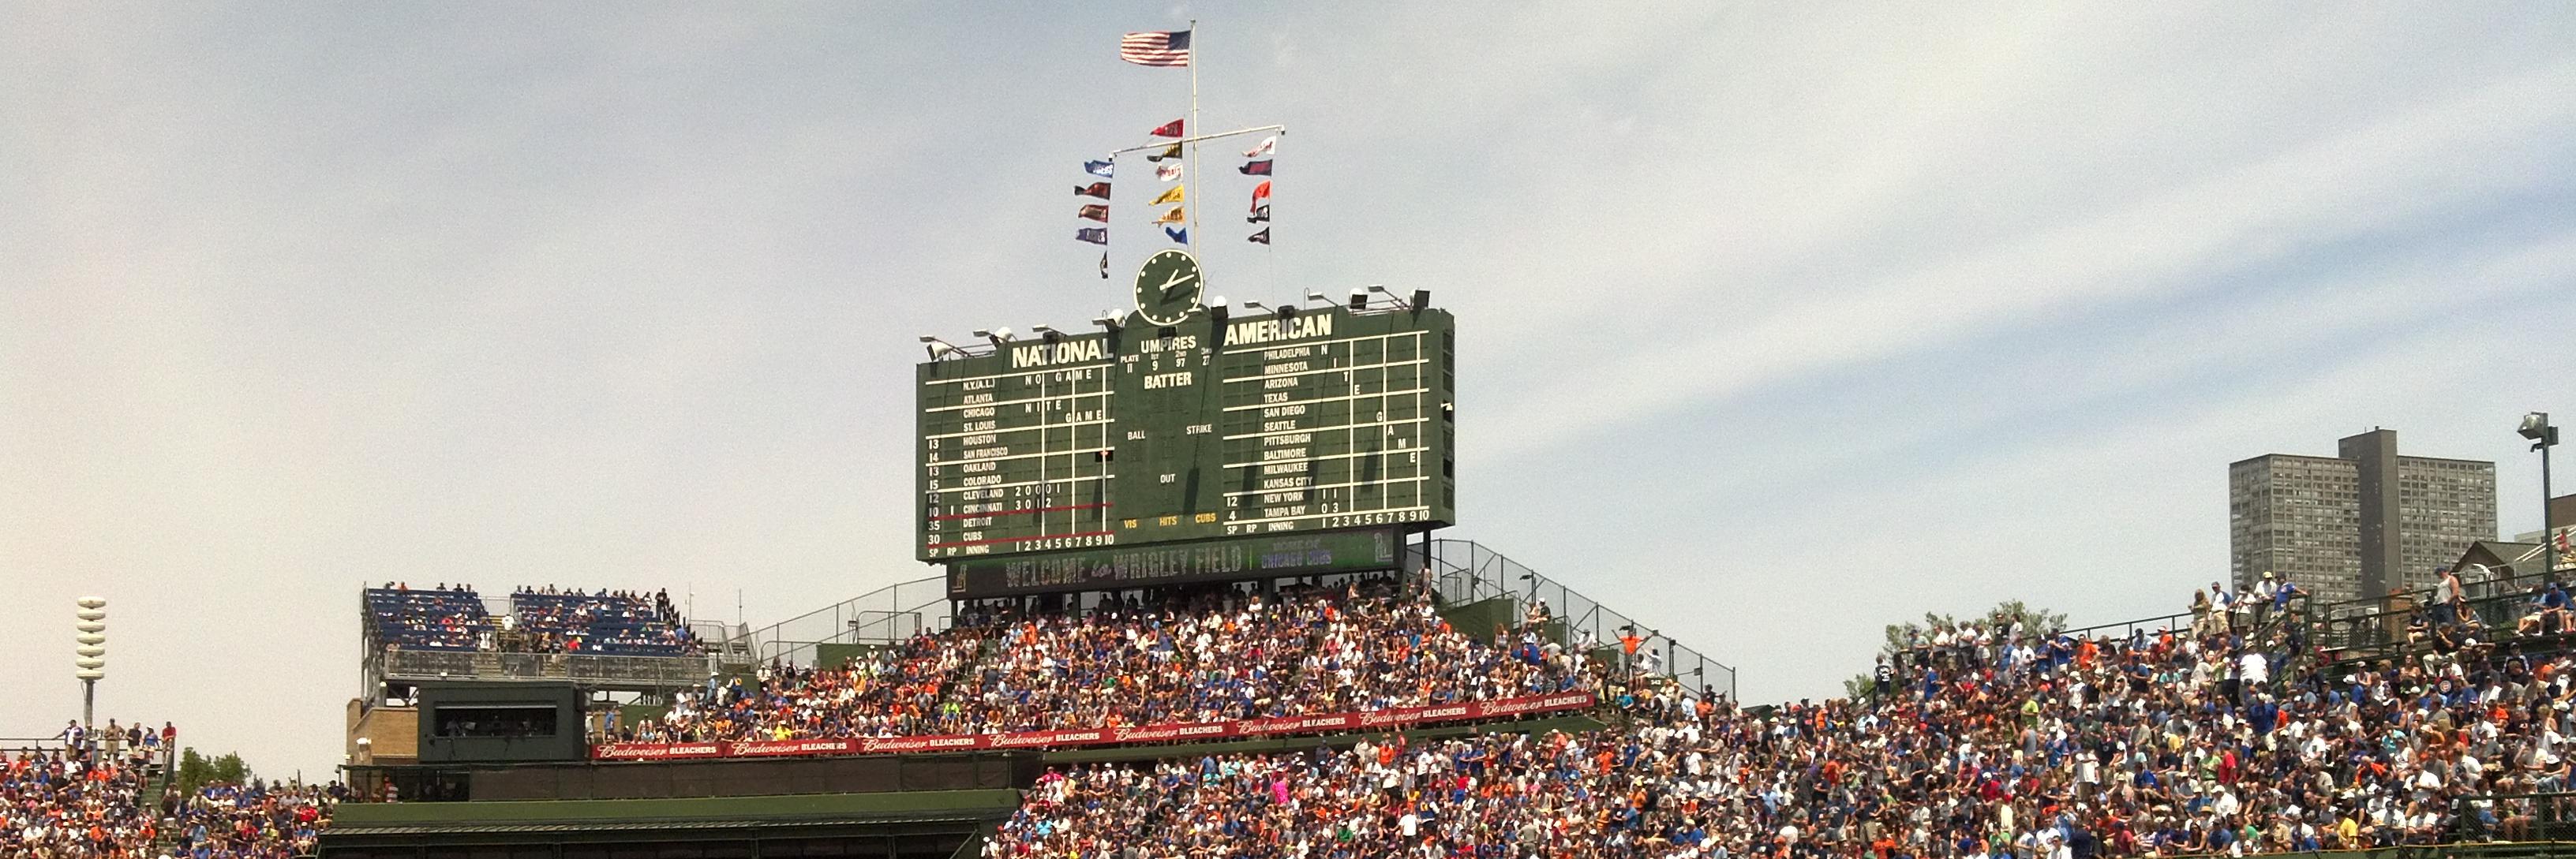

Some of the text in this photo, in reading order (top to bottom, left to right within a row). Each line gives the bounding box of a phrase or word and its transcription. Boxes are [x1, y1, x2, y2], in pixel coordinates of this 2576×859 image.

[1224, 314, 1332, 346] AMERICAN
[1140, 335, 1196, 353] UMPIRES
[1013, 339, 1114, 368] NATIONAL
[1121, 354, 1140, 363] PLATE
[1264, 347, 1310, 360] PHILADELPHIA
[1152, 360, 1159, 371] 9
[1176, 357, 1185, 367] 97
[1264, 362, 1308, 375] MINNESOTA
[1144, 372, 1192, 389] BATTER
[1264, 377, 1298, 389] ARIZONA
[963, 393, 993, 405] ATLANTA
[1264, 392, 1288, 404] TEXAS
[963, 407, 995, 418] CHICAGO
[1264, 405, 1305, 418] SAN DIEGO
[975, 420, 995, 431] LOUIS
[1186, 424, 1212, 435] STRIKE
[1264, 420, 1296, 431] SEATTLE
[929, 435, 996, 449] 13 HOUSTON
[1128, 430, 1145, 441] BALL
[1264, 433, 1311, 446] PITTSBURGH
[929, 446, 1008, 462] 14 SAN FRANCISCO
[1264, 448, 1306, 461] BALTIMORE
[929, 462, 996, 476] 13 OAKLAND
[1264, 462, 1309, 475] MILWAUKEE
[929, 475, 1002, 490] 15 COLORADO
[1160, 473, 1175, 484] OUT
[1264, 476, 1312, 488] KANSAS CITY
[929, 494, 939, 503] 12
[963, 489, 1004, 500] CLEVELAND
[1226, 496, 1237, 506] 12
[1264, 492, 1281, 503] NEW
[1282, 491, 1304, 502] YORK
[929, 507, 939, 517] 10
[963, 502, 1002, 514] CINCINNATI
[1264, 506, 1289, 517] TAMPA
[1291, 505, 1305, 516] BAY
[929, 517, 991, 531] 35 DETROIT
[1124, 513, 1216, 528] VIS HITS CUBS
[1227, 525, 1237, 535] SP
[1246, 523, 1257, 533] RP
[1268, 521, 1294, 532] INNING
[929, 532, 983, 544] 30 CUBS
[929, 547, 938, 557] SP
[947, 547, 957, 556] RP
[966, 544, 990, 555] INNING
[1307, 550, 1332, 566] CUBS
[1006, 556, 1085, 587] WELCOME
[1114, 549, 1188, 580] WRIGLEY
[1195, 545, 1242, 574] FIELD
[1480, 695, 1587, 715] Budweiser BLEACHERS
[1359, 707, 1466, 726] Budweiser BLEACHERS
[1114, 725, 1222, 741] Budweiser BLEACHERS
[1237, 718, 1346, 734] Budweiser BLEACHERS
[862, 737, 975, 751] Budweiser BLEACHERS
[988, 732, 1099, 747] Budweiser BLEACHERS
[597, 742, 717, 758] Budweiser BLEACHERS
[731, 741, 847, 756] Budweiser BLEACHERS
